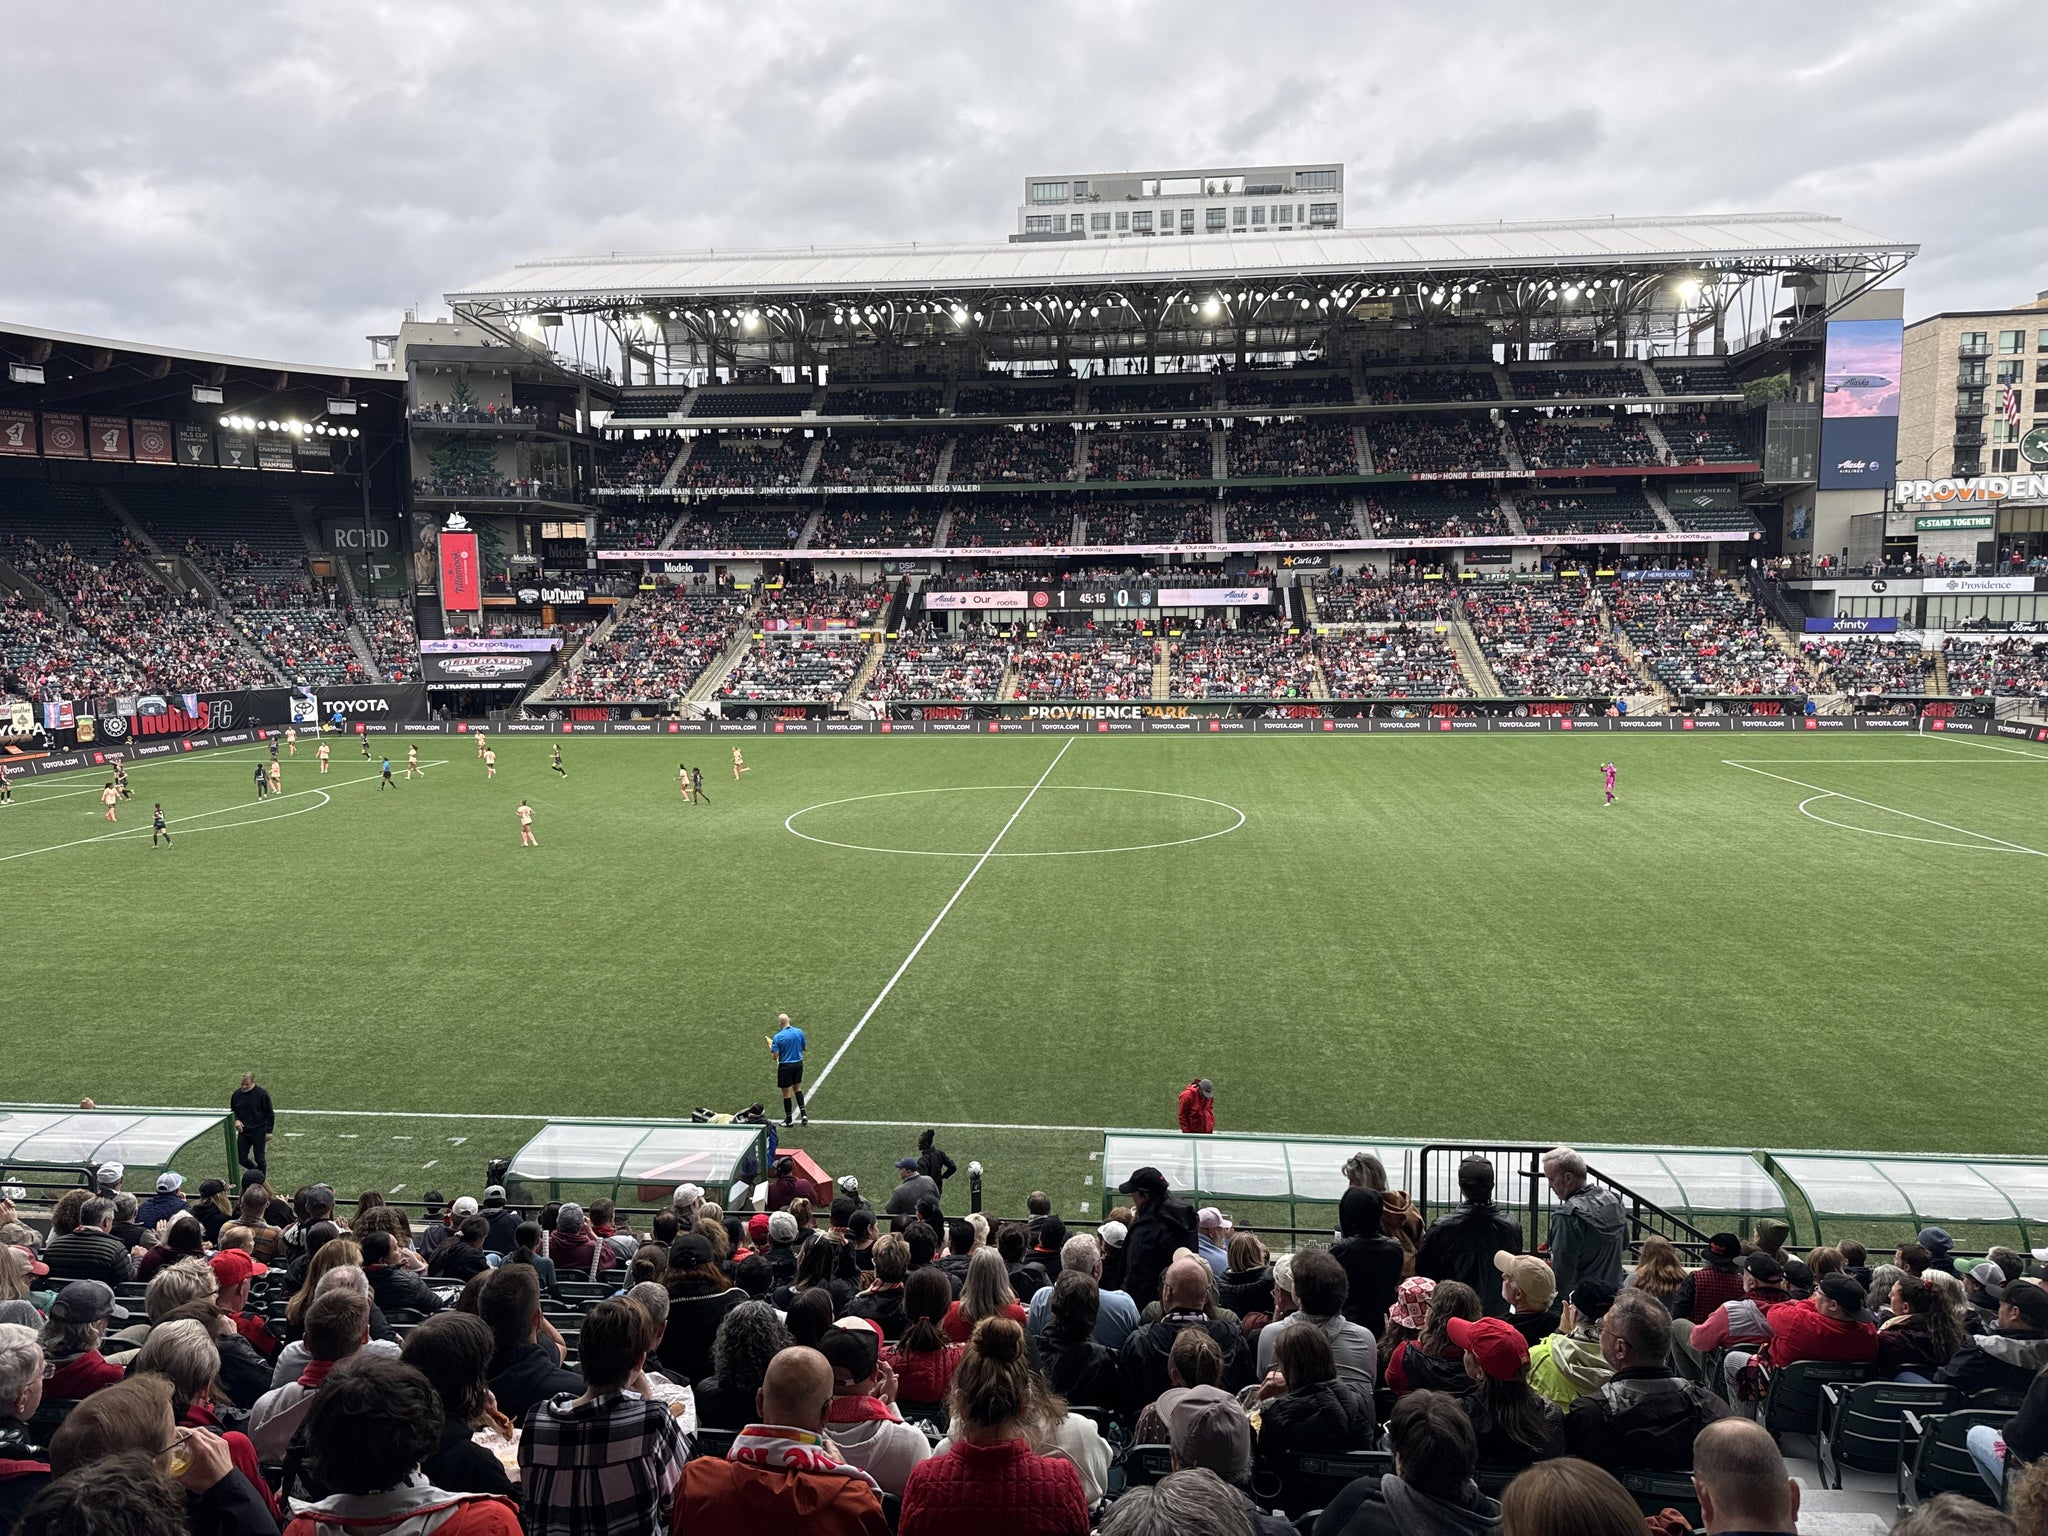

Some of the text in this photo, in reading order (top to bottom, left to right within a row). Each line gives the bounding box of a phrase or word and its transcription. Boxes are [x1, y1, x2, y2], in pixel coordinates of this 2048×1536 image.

[1838, 460, 1866, 468] Alaska
[1472, 470, 1505, 479] CHRISTINE
[1896, 478, 2048, 503] PROVIDEN
[1927, 517, 1991, 527] STAND TOGETHER
[335, 529, 389, 547] RCTID
[1312, 556, 1322, 565] Jr.
[455, 550, 464, 593] Tillamook
[664, 562, 693, 572] Modelo
[1961, 580, 2011, 590] Providence
[973, 595, 991, 604] Our
[1058, 591, 1065, 607] 1
[1079, 593, 1105, 603] 45:15
[1117, 590, 1128, 607] 0
[1224, 590, 1248, 599] Alaska
[1833, 619, 1868, 630] xfinity
[2010, 622, 2038, 632] Ford
[323, 699, 389, 714] TOYOTA
[1409, 704, 1458, 718] EST 2012
[1528, 703, 1572, 718] THORNS
[1728, 702, 1781, 716] EST 2012
[208, 700, 232, 729] FC
[569, 708, 620, 721] THORNS FC
[761, 707, 806, 720] EST 2012
[923, 706, 963, 720] THORNS
[1029, 706, 1190, 720] PROVIDENCE PARK
[1997, 726, 2026, 735] TOYOTA.COM
[221, 734, 247, 743] TOYOTA.COM
[139, 746, 169, 754] TOYOTA.COM
[42, 759, 78, 769] TOYOTA.COM
